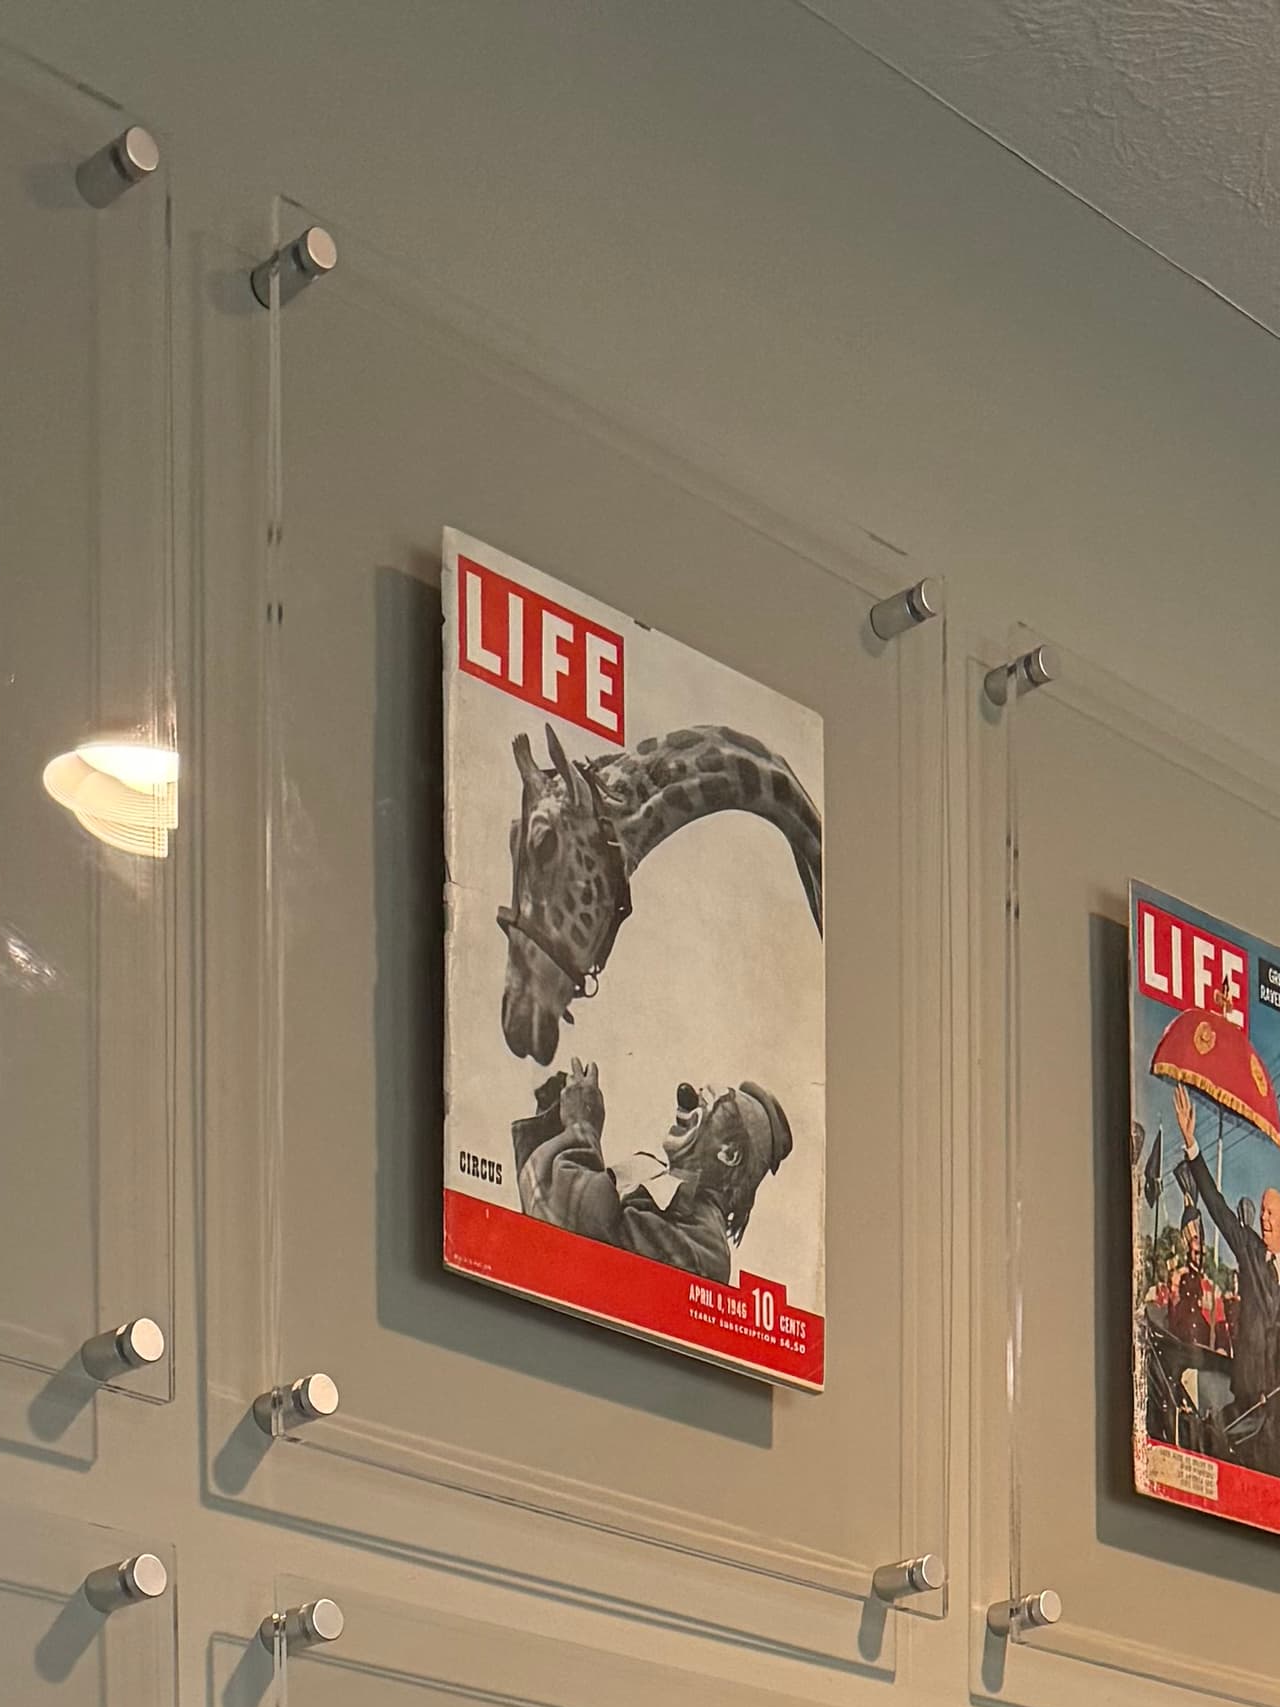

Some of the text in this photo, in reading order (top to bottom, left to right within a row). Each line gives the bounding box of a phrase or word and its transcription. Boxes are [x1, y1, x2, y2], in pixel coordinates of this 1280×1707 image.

[466, 571, 618, 732] LIFE
[1144, 911, 1244, 1028] LIFE
[460, 1151, 502, 1185] CIRCUS
[689, 1284, 714, 1308] APRIL
[728, 1297, 747, 1319] 1946
[752, 1288, 774, 1331] 10
[780, 1316, 806, 1339] CENTS
[720, 1319, 776, 1344] SUBSCRIPTION
